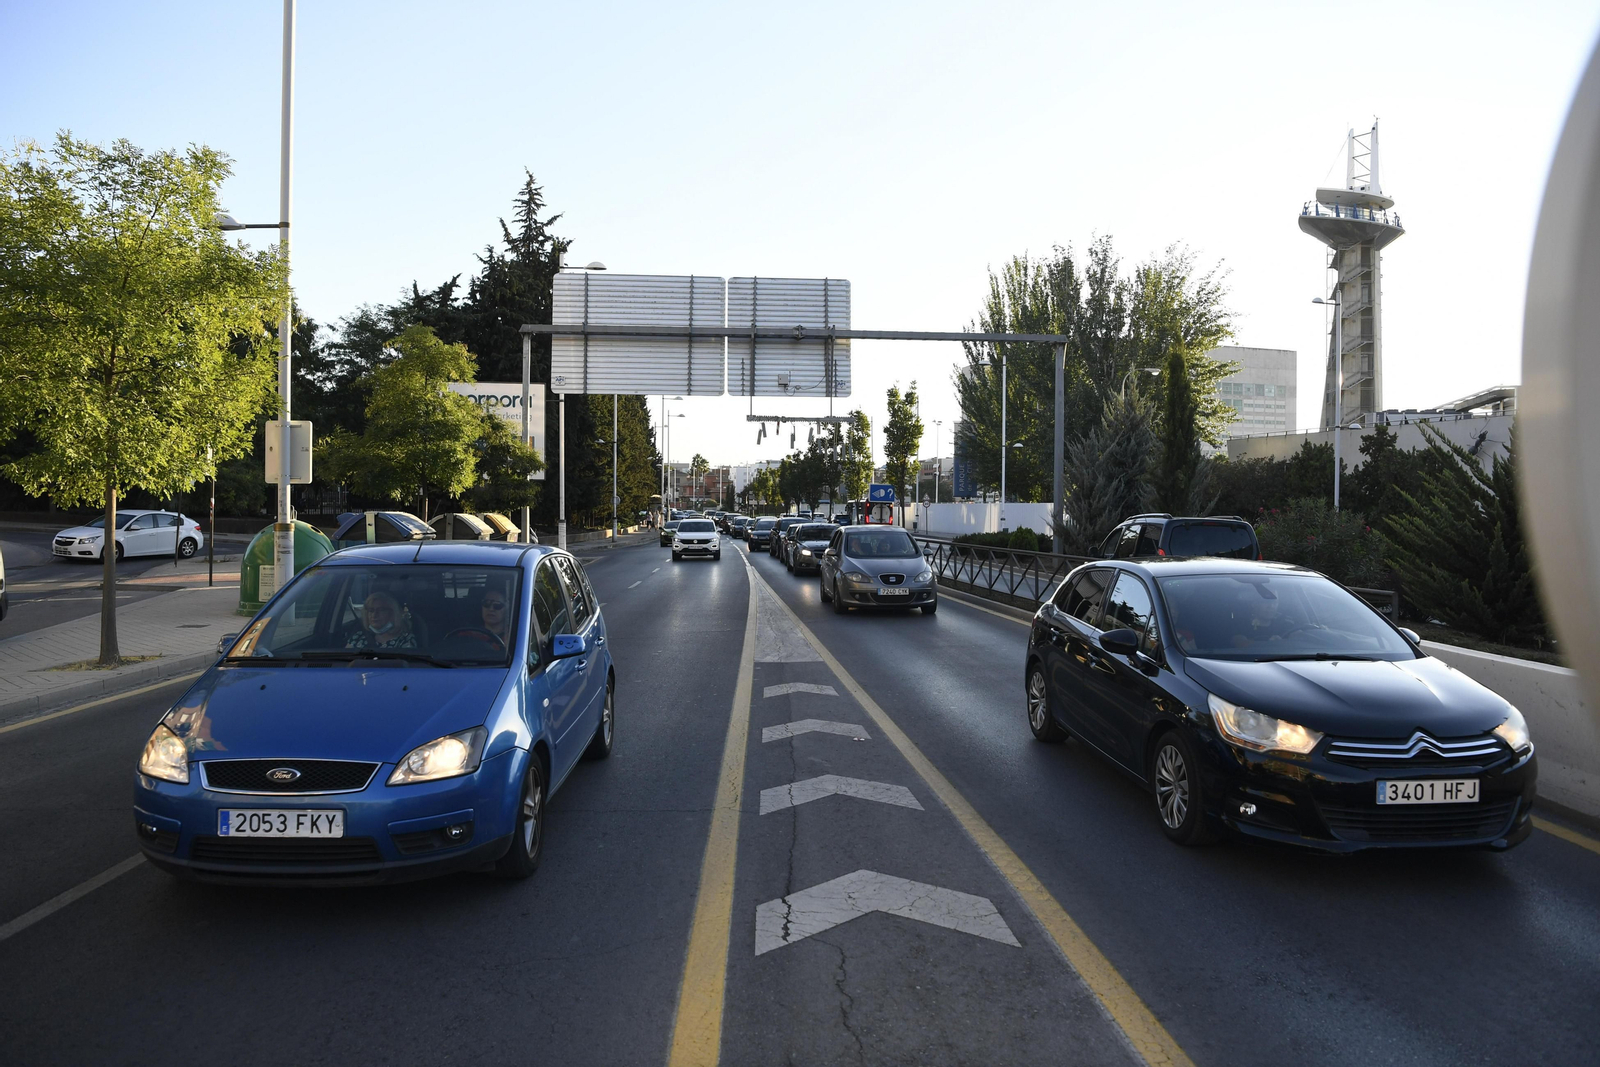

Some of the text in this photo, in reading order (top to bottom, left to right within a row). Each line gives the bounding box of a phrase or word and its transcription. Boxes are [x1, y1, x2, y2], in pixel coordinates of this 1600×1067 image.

[273, 770, 293, 779] Ford
[1388, 783, 1435, 801] 3401
[1443, 782, 1477, 800] HFJ
[235, 813, 288, 833] 2053
[296, 814, 337, 834] FKY
